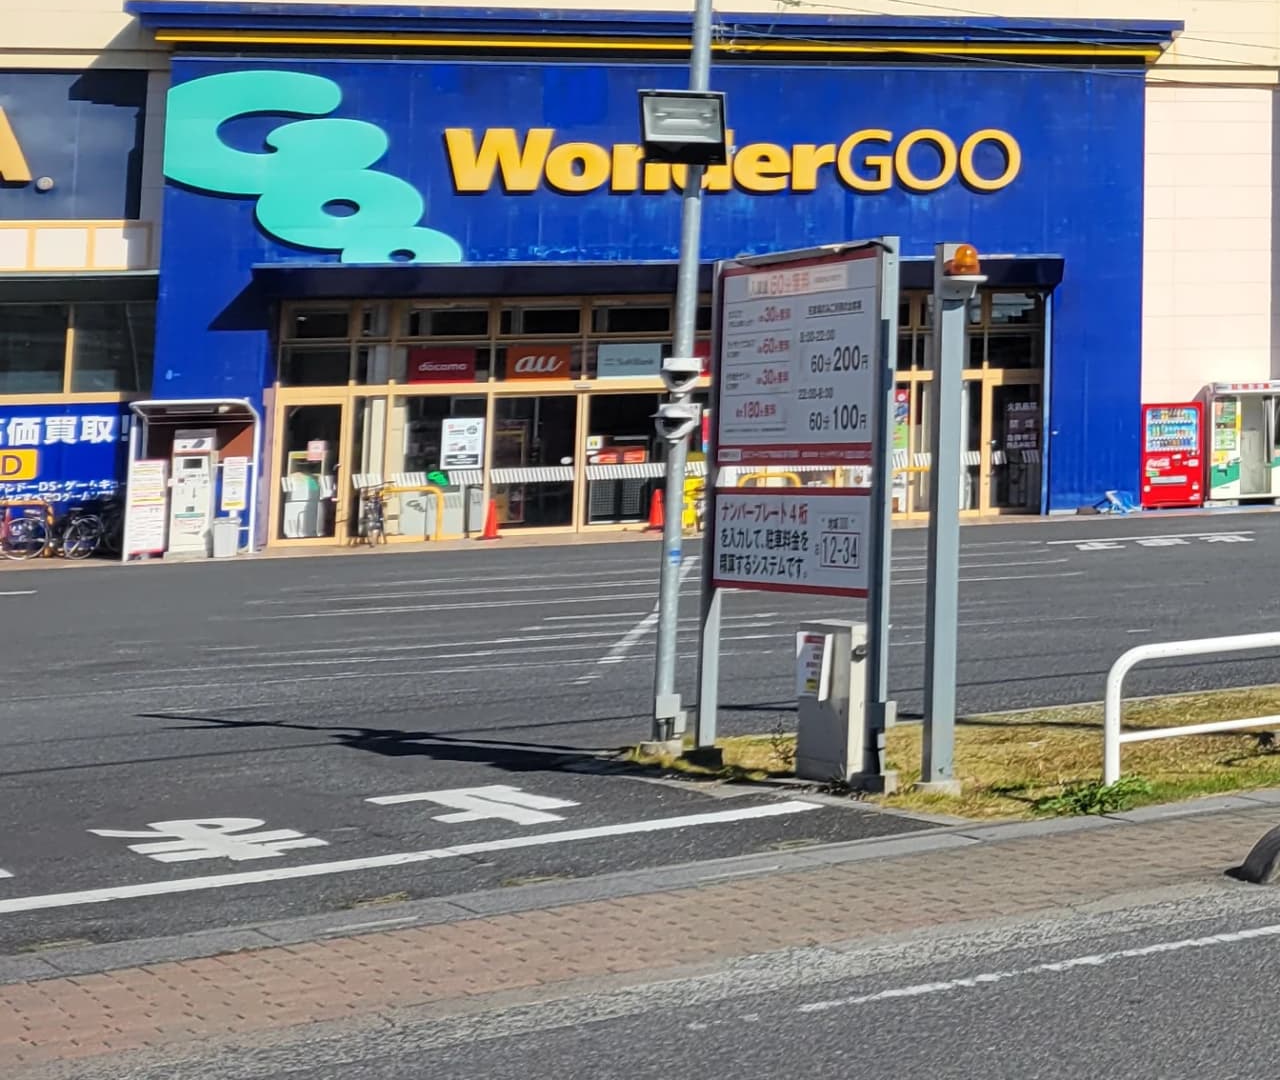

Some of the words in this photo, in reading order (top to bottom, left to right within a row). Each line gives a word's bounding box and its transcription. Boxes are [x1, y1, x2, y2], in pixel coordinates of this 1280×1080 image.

[418, 361, 467, 371] docomo
[515, 355, 564, 373] au
[809, 404, 867, 431] 60分100円
[822, 536, 857, 565] 12-34
